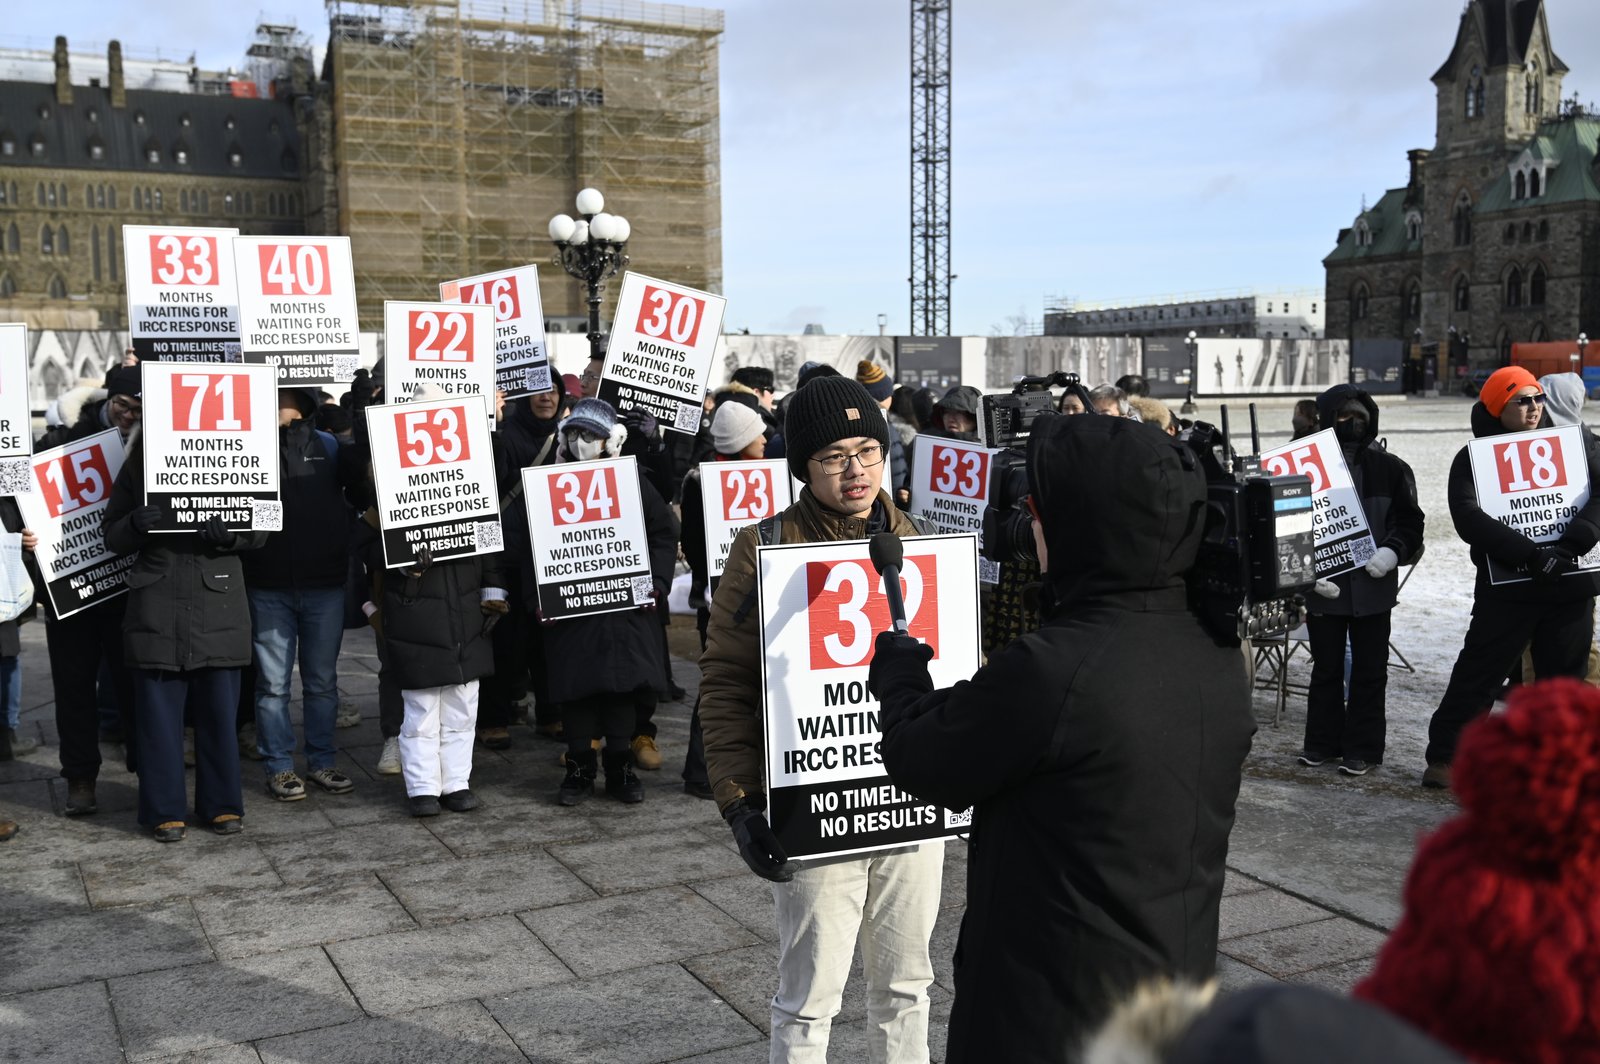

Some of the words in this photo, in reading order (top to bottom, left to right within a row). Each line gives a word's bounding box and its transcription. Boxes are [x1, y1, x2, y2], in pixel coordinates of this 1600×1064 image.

[157, 235, 212, 285] 33
[268, 245, 324, 295] 40
[160, 292, 213, 303] MONTHS
[146, 306, 199, 318] WAITING
[204, 307, 228, 318] FOR
[270, 303, 325, 314] MONTHS
[643, 289, 697, 343] 30
[139, 322, 167, 332] IRCC
[170, 321, 236, 332] RESPONSE
[257, 318, 312, 329] WAITING
[317, 318, 341, 328] FOR
[250, 334, 279, 344] IRCC
[282, 333, 350, 344] RESPONSE
[415, 312, 467, 360] 22
[510, 336, 531, 348] FOR
[153, 342, 168, 352] NO
[170, 342, 224, 352] TIMELINES
[496, 347, 539, 364] SPONSE
[637, 341, 686, 362] MONTHS
[176, 355, 221, 363] RESULTS
[265, 355, 281, 365] NO
[622, 352, 670, 373] WAITING
[673, 365, 695, 379] FOR
[415, 368, 467, 379] MONTHS
[611, 364, 637, 379] IRCC
[638, 372, 699, 395] RESPONSE
[457, 383, 480, 394] FOR
[618, 387, 632, 398] NO
[181, 375, 242, 430] 71
[620, 399, 633, 410] NO
[181, 439, 243, 451] MONTHS
[405, 408, 462, 466] 53
[165, 456, 227, 468] WAITING
[232, 456, 260, 468] FOR
[1503, 439, 1558, 491] 18
[156, 473, 189, 485] IRCC
[192, 473, 269, 485] RESPONSE
[408, 468, 464, 487] MONTHS
[936, 448, 981, 497] 33
[45, 449, 104, 515] 15
[171, 497, 189, 508] NO
[396, 487, 451, 505] WAITING
[455, 482, 480, 497] FOR
[556, 468, 613, 524] 34
[727, 470, 769, 519] 23
[1510, 493, 1563, 510] MONTHS
[389, 509, 419, 522] IRCC
[421, 497, 490, 517] RESPONSE
[934, 498, 977, 515] MONTHS
[1325, 505, 1348, 519] FOR
[61, 508, 105, 534] MONTH
[177, 511, 194, 522] NO
[922, 509, 965, 526] WAITING
[968, 518, 983, 529] FO
[1498, 510, 1552, 526] WAITING
[1556, 506, 1578, 518] FOR
[405, 530, 421, 542] NO
[562, 527, 616, 544] MONTHS
[1314, 516, 1359, 541] SPONSE
[412, 542, 428, 554] NO
[550, 544, 603, 561] WAITING
[607, 540, 631, 553] FOR
[50, 552, 79, 573] IRCC
[544, 563, 572, 577] IRCC
[575, 554, 641, 573] RESPONSE
[70, 575, 85, 589] NO
[78, 585, 94, 599] NO
[95, 569, 131, 592] RESULT
[560, 585, 575, 596] NO
[576, 578, 631, 594] TIMELINES
[566, 598, 581, 608] NO
[583, 591, 628, 606] RESULTS
[797, 710, 883, 741] WAITIN
[784, 746, 838, 774] IRCC
[810, 791, 839, 814] NO
[821, 816, 848, 838] NO
[854, 805, 937, 834] RESULTS
